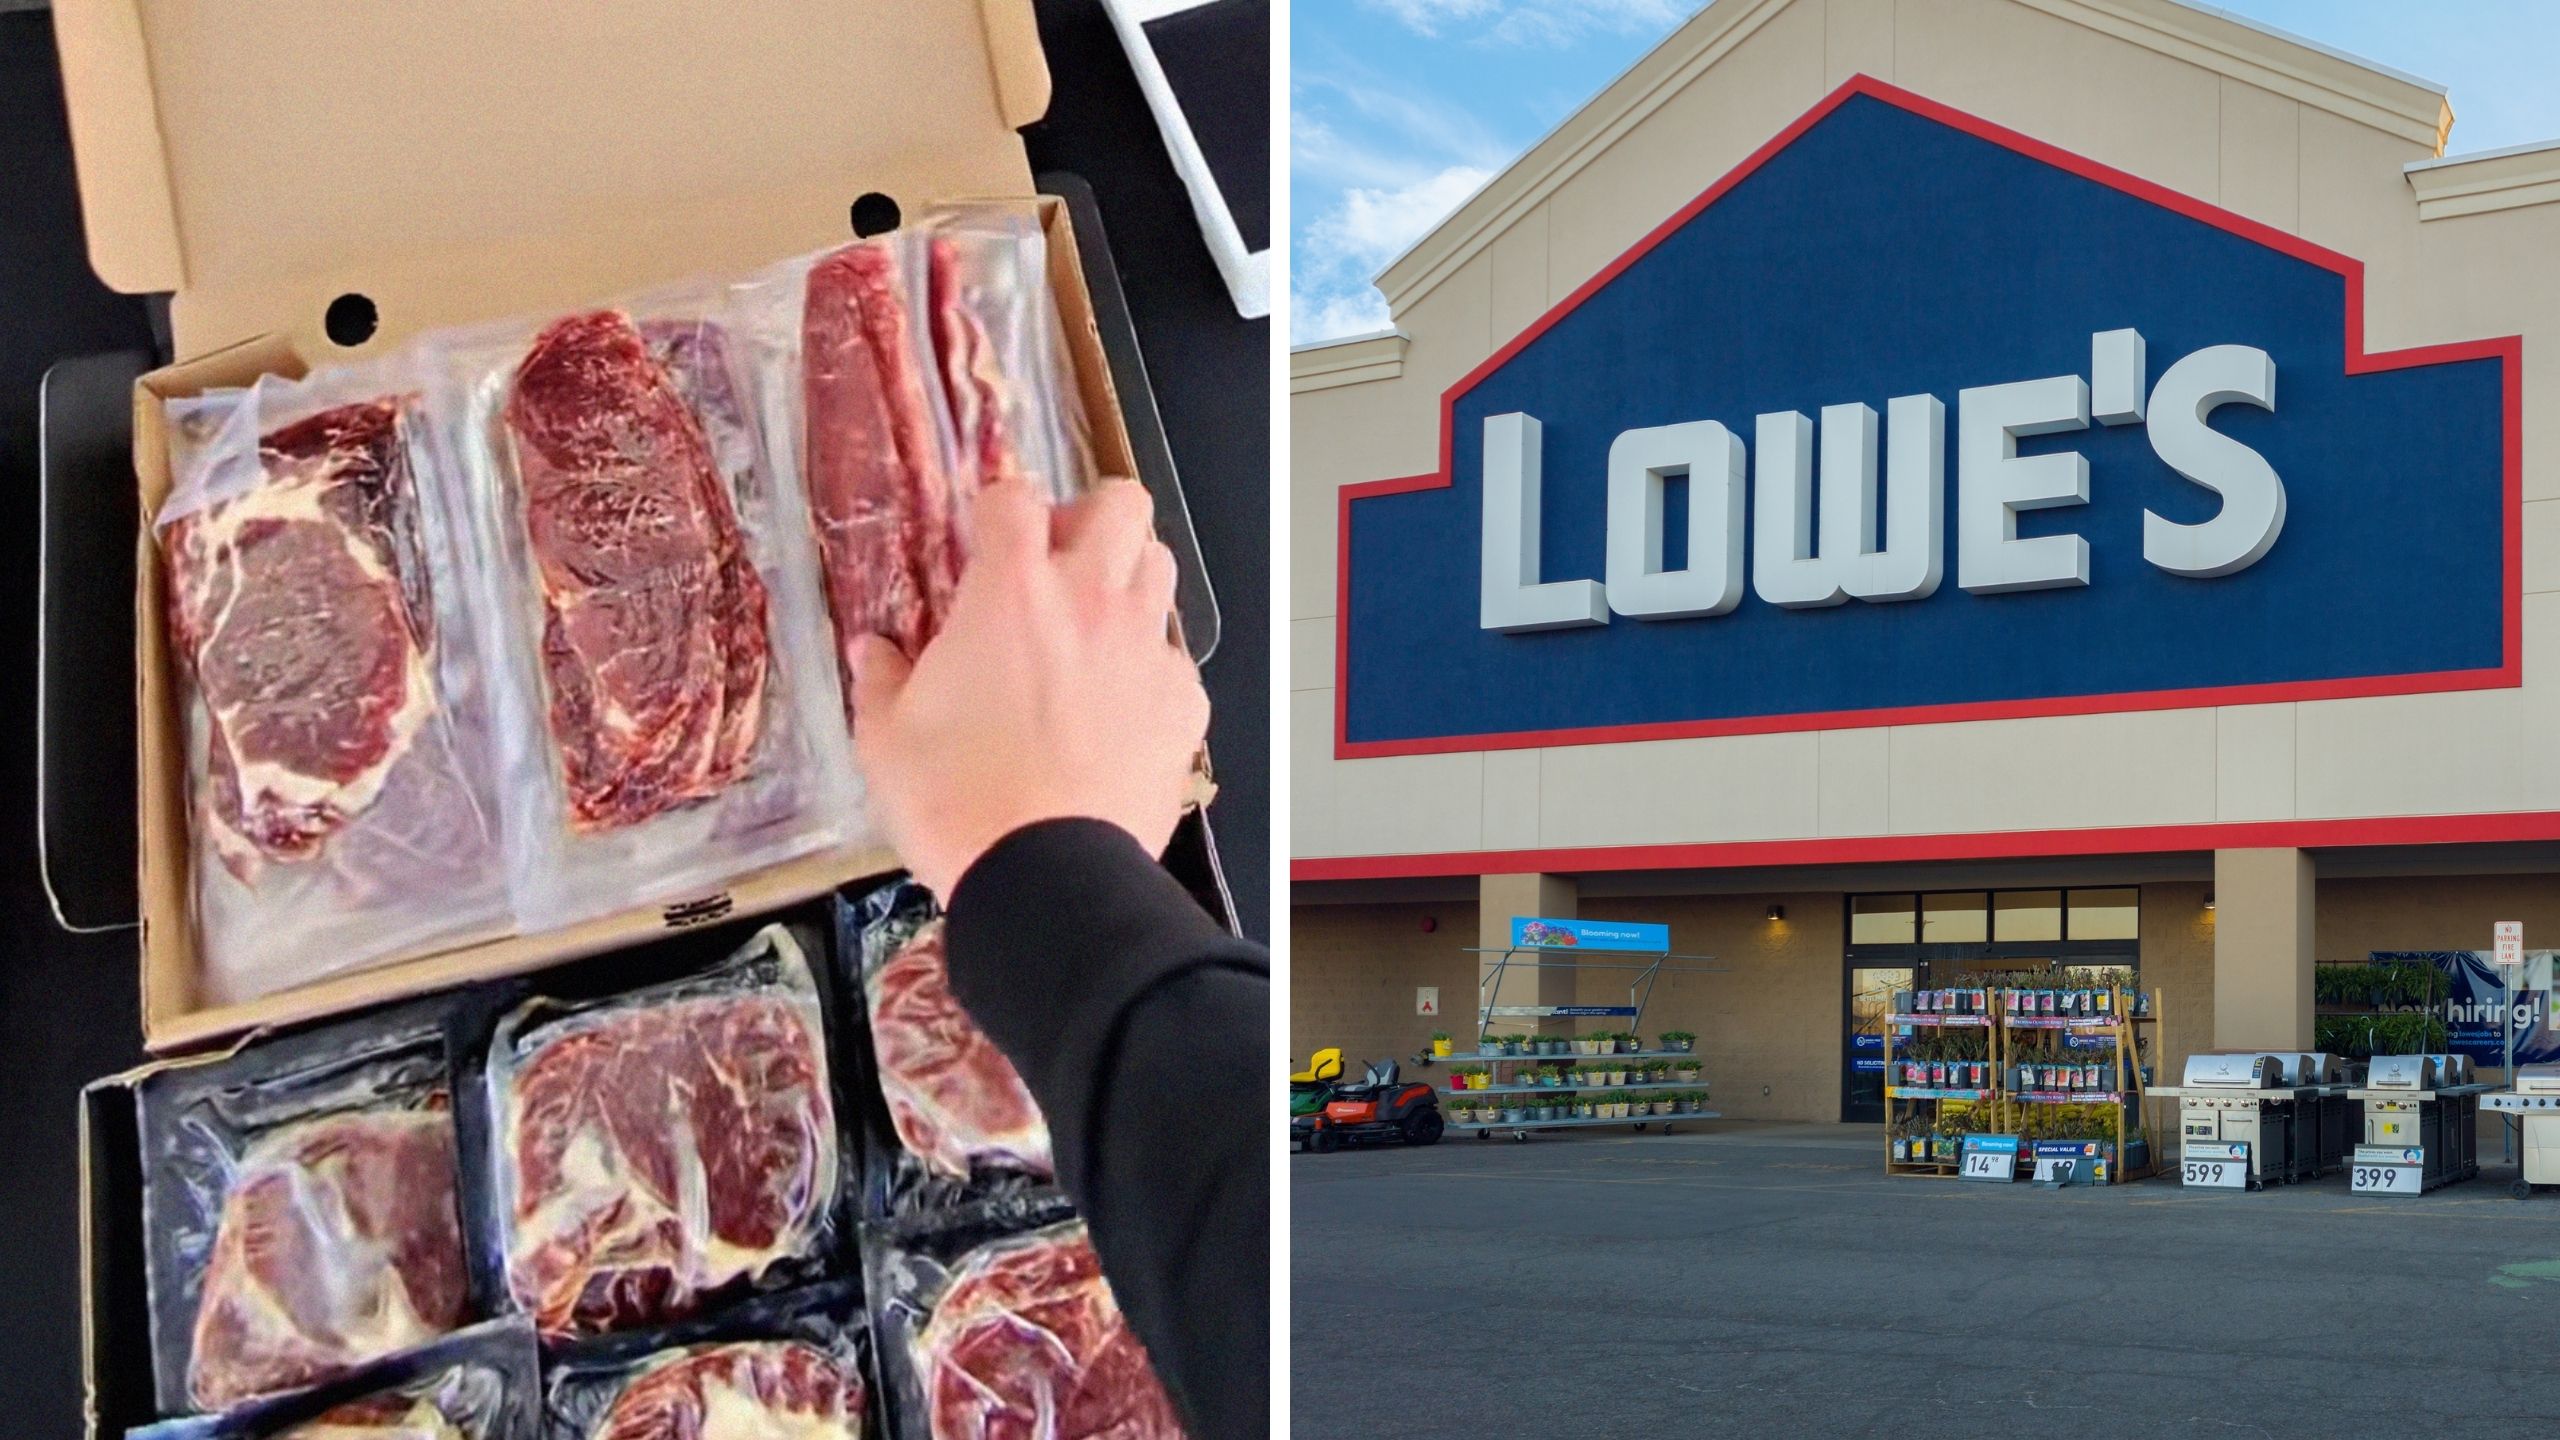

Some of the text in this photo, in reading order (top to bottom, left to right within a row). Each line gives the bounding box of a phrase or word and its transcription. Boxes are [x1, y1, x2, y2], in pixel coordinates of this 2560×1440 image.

[1481, 328, 2286, 634] LOWE'S
[1581, 929, 1640, 939] Blooming now!
[2448, 997, 2540, 1029] hiring!
[1970, 1155, 1989, 1173] 14
